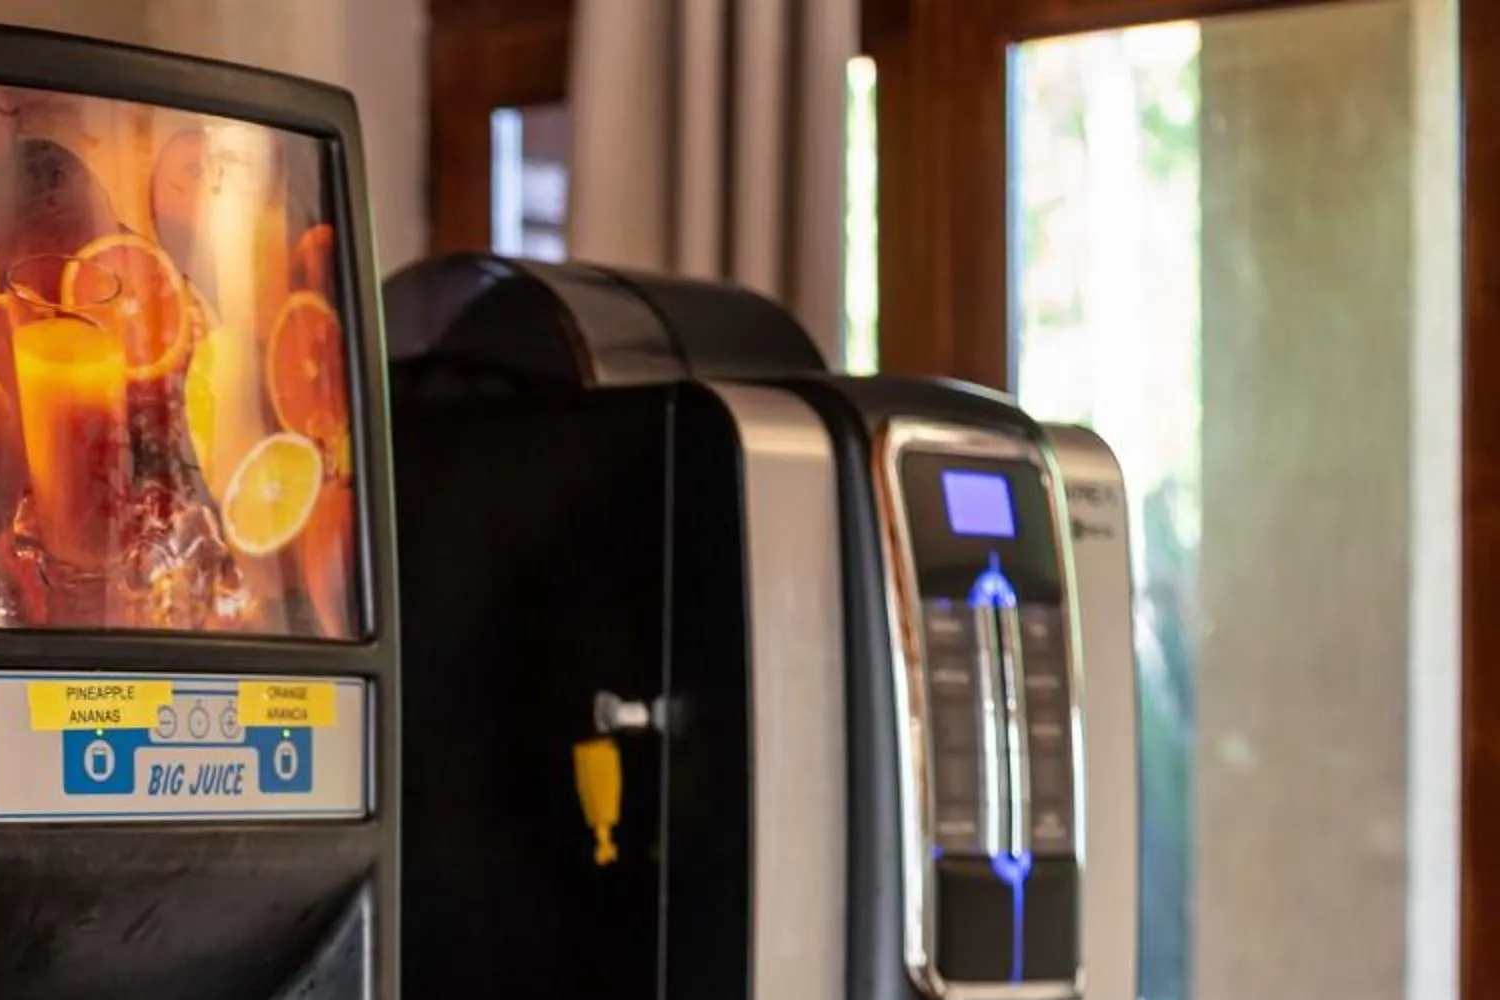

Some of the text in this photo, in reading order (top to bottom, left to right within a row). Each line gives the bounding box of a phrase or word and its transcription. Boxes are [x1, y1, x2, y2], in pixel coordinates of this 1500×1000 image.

[66, 686, 135, 700] PINEAPPLE
[266, 686, 308, 700] ORANGE
[69, 709, 121, 723] ANANAS
[148, 763, 245, 795] BIG JUICE
